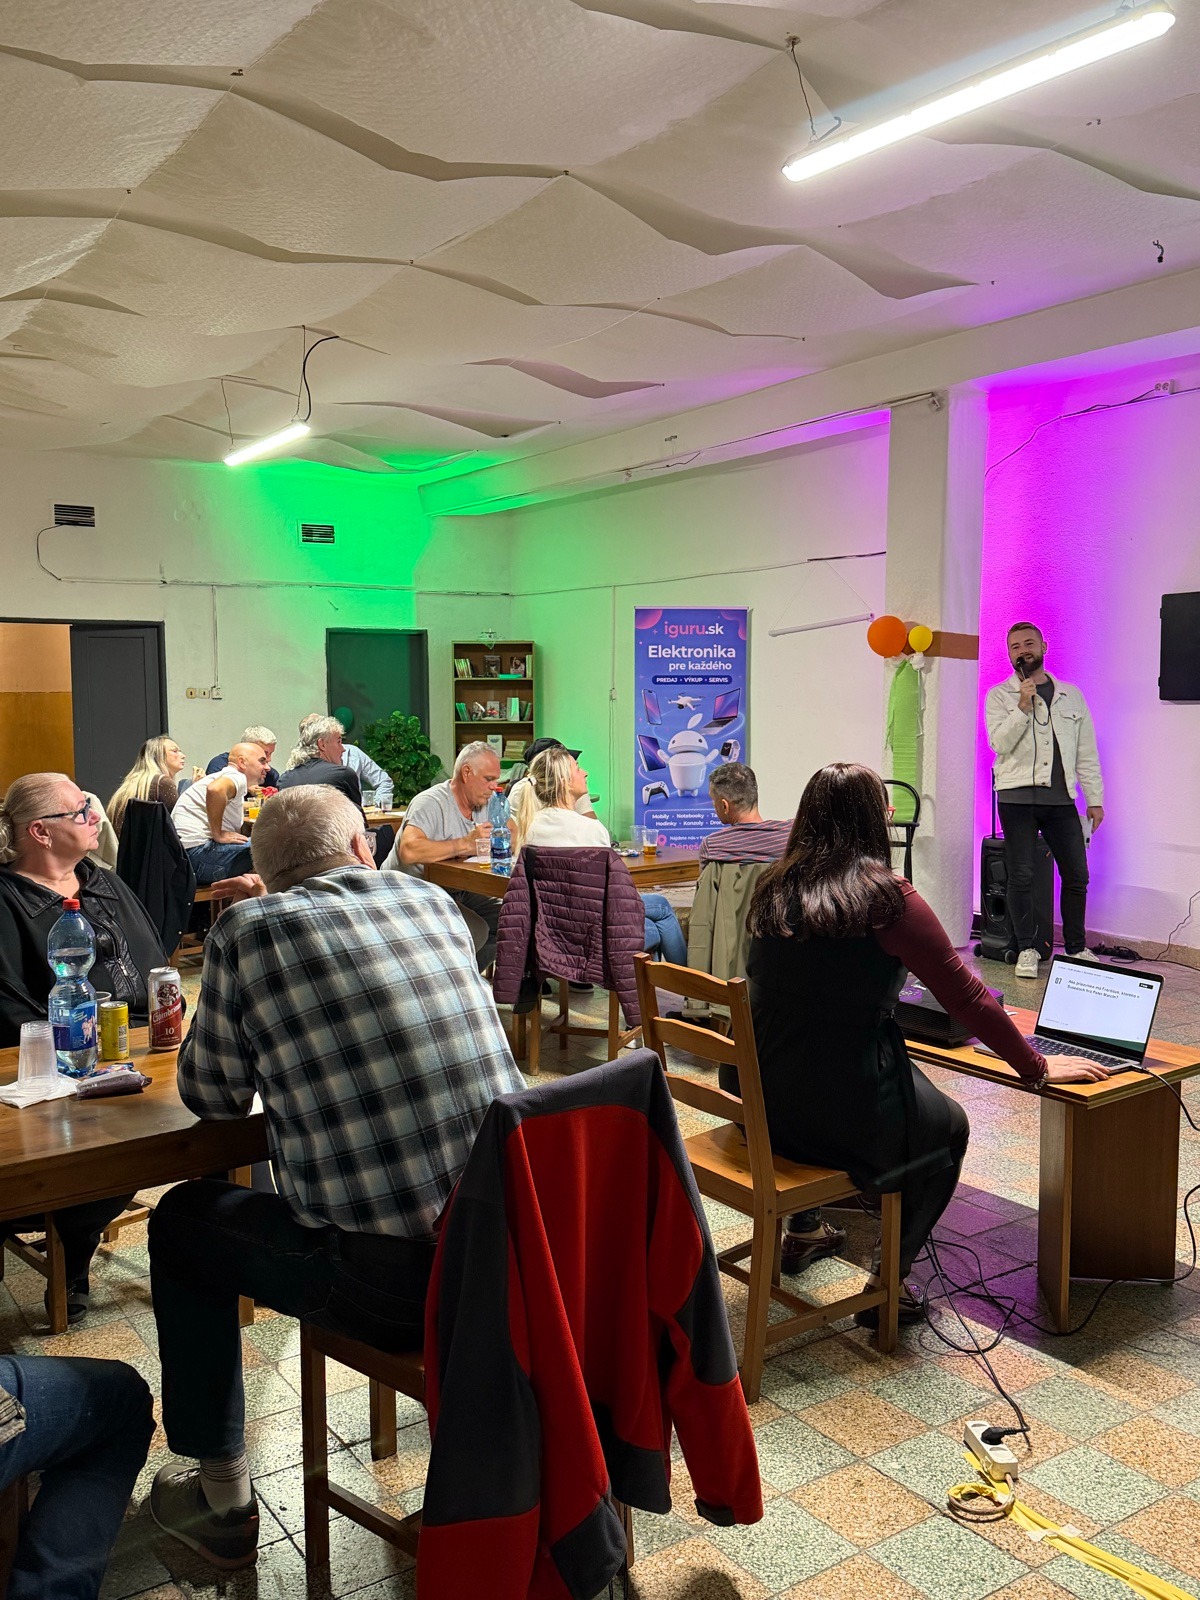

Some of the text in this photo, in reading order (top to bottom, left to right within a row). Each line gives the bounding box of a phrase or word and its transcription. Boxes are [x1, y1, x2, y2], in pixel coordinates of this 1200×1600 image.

[664, 621, 724, 638] iguru.sk
[648, 644, 736, 658] Elektronika
[669, 661, 732, 672] pre každého
[165, 1027, 175, 1036] 10
